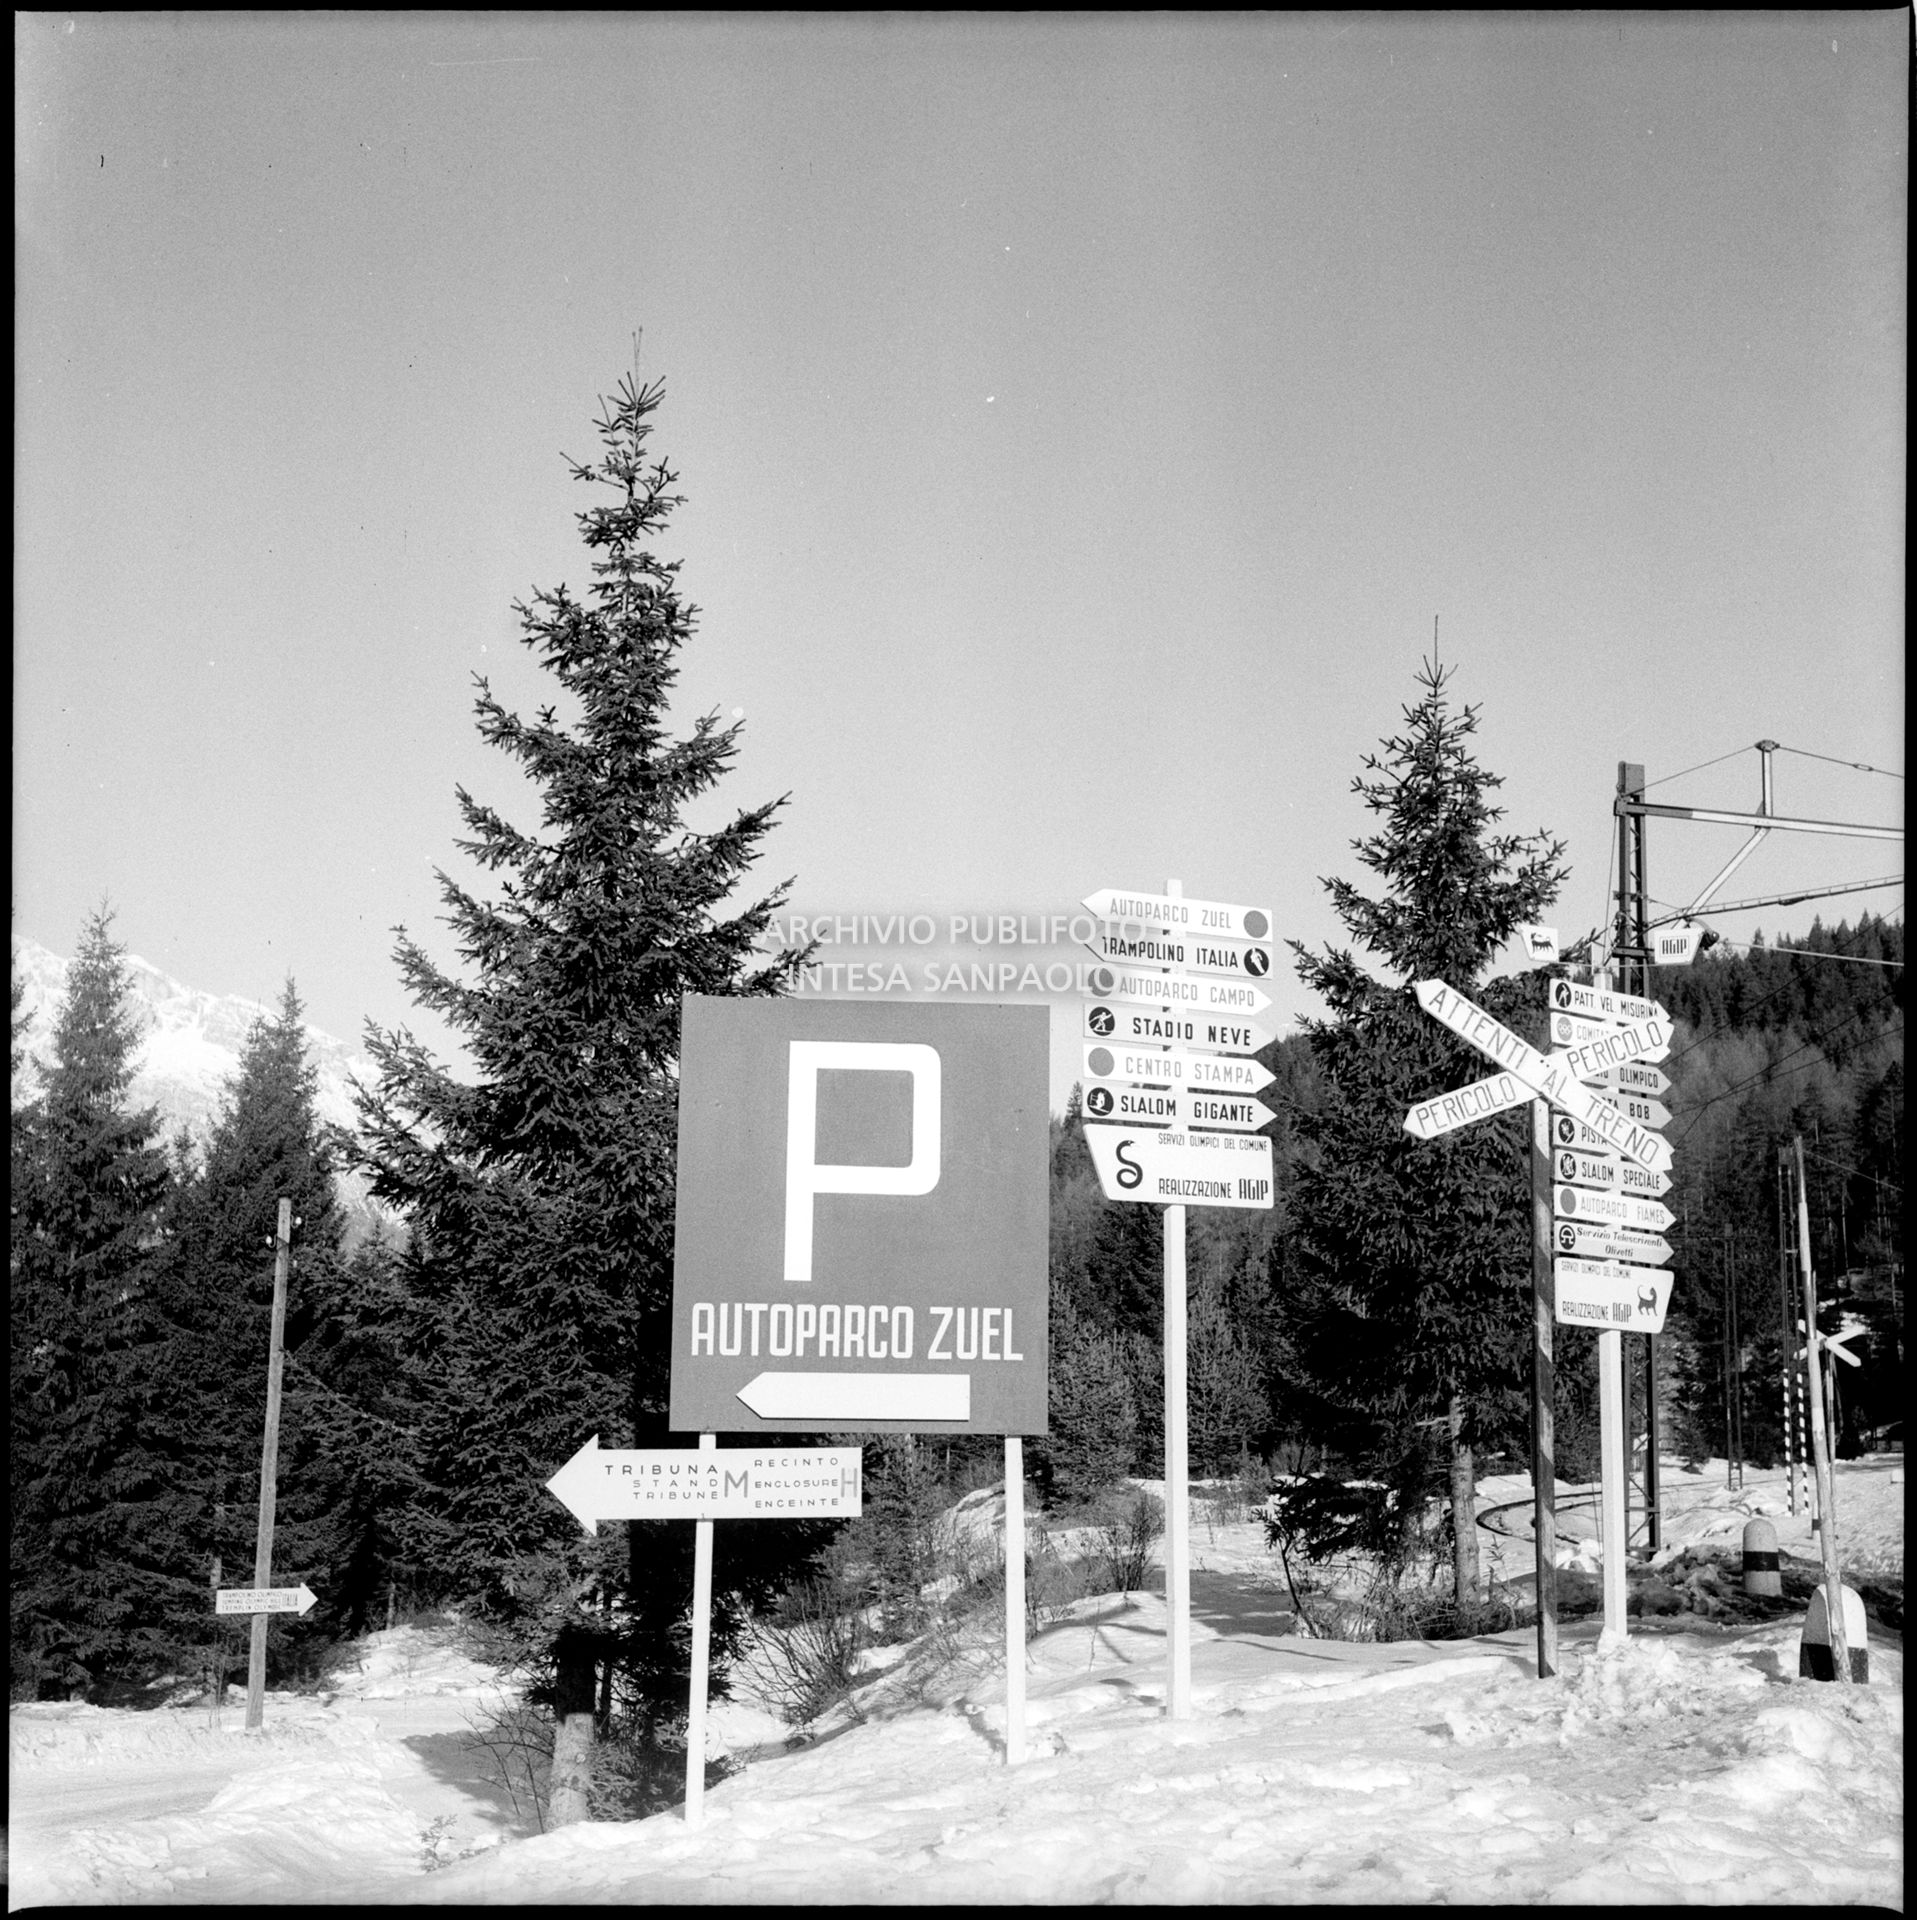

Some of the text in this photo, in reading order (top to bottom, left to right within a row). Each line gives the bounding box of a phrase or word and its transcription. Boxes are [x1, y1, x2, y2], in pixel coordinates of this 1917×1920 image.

[1110, 898, 1232, 929] AUTOPARCO ZUEL
[1101, 936, 1239, 969] TRAMPOLINO ITALIA
[1661, 937, 1688, 955] AGIP
[1119, 976, 1255, 1008] AUTOPARCO CAMPO
[1620, 1000, 1658, 1019] MISURINA
[1132, 1017, 1251, 1047] STADIO NEVE
[1576, 1025, 1610, 1041] COMIT
[1566, 1020, 1664, 1078] PERICOLO
[1125, 1056, 1254, 1085] CENTRO STAMPA
[1428, 987, 1660, 1165] ATTENTI AL TRENO
[1619, 1067, 1659, 1088] OLIMPICO
[1121, 1095, 1254, 1123] SLALOM GIGANTE
[1415, 1076, 1517, 1136] PERICOLO
[1629, 1102, 1650, 1120] BOB
[1158, 1132, 1267, 1152] SERVIZI OLIMPICI DEL COMUNE
[783, 1040, 942, 1282] P
[1581, 1161, 1661, 1190] SLALOM SPECIALE
[1158, 1177, 1269, 1201] REALIZZAZIONE AGIP
[1580, 1197, 1666, 1225] AUTOPARCO FIAMES
[1576, 1226, 1663, 1248] Servizio Telescriventi
[1605, 1244, 1634, 1257] Olivetti
[1612, 1302, 1632, 1323] AGIP
[691, 1302, 1024, 1361] AUTOPARCO ZUEL
[604, 1464, 719, 1476] TRIBUNA
[753, 1457, 839, 1468] RECINTO
[632, 1478, 719, 1488] STAND
[632, 1490, 720, 1500] TRIBUNE
[724, 1469, 749, 1499] M
[754, 1478, 839, 1489] ENCLOSURE
[840, 1467, 858, 1499] H
[754, 1498, 839, 1509] ENCEINTE
